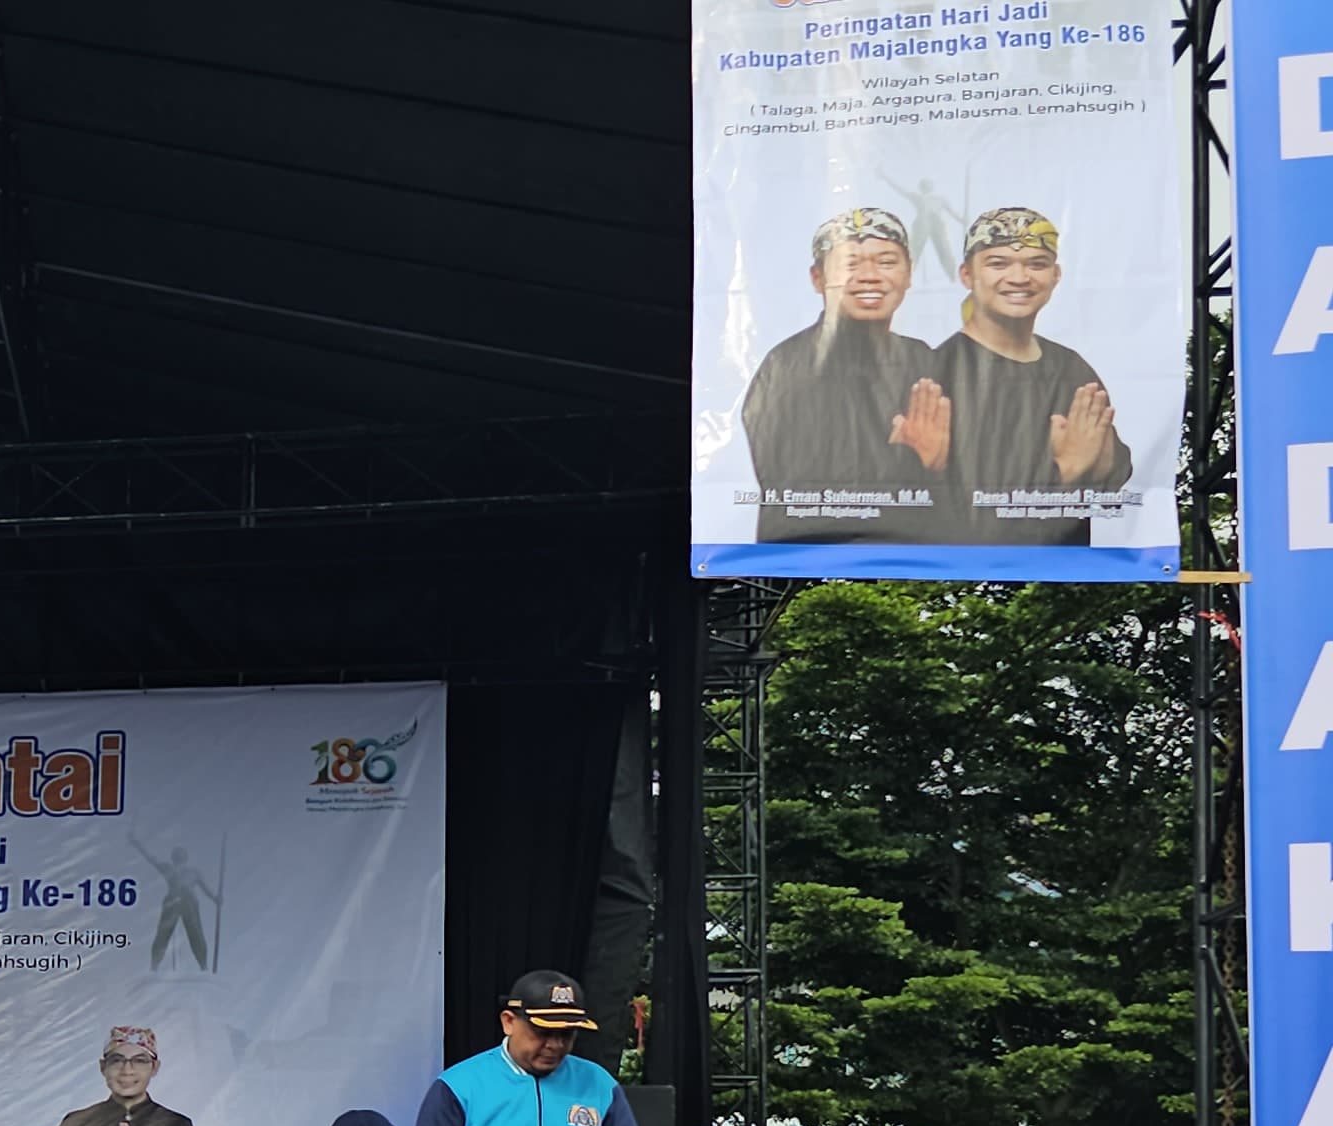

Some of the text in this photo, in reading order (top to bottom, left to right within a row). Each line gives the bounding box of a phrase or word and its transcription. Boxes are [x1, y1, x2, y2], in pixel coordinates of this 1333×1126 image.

[805, 1, 1049, 40] Peringatan Hari Jadi
[719, 24, 1146, 72] Kabupaten Majalengka Yang Ke-186
[861, 69, 1000, 91] Wilayah Selatan
[1027, 98, 1134, 118] Lemahsugih
[783, 490, 822, 503] Eman
[973, 491, 1010, 504] Dena
[22, 877, 138, 907] Ke-186
[54, 930, 132, 949] Cikijing,
